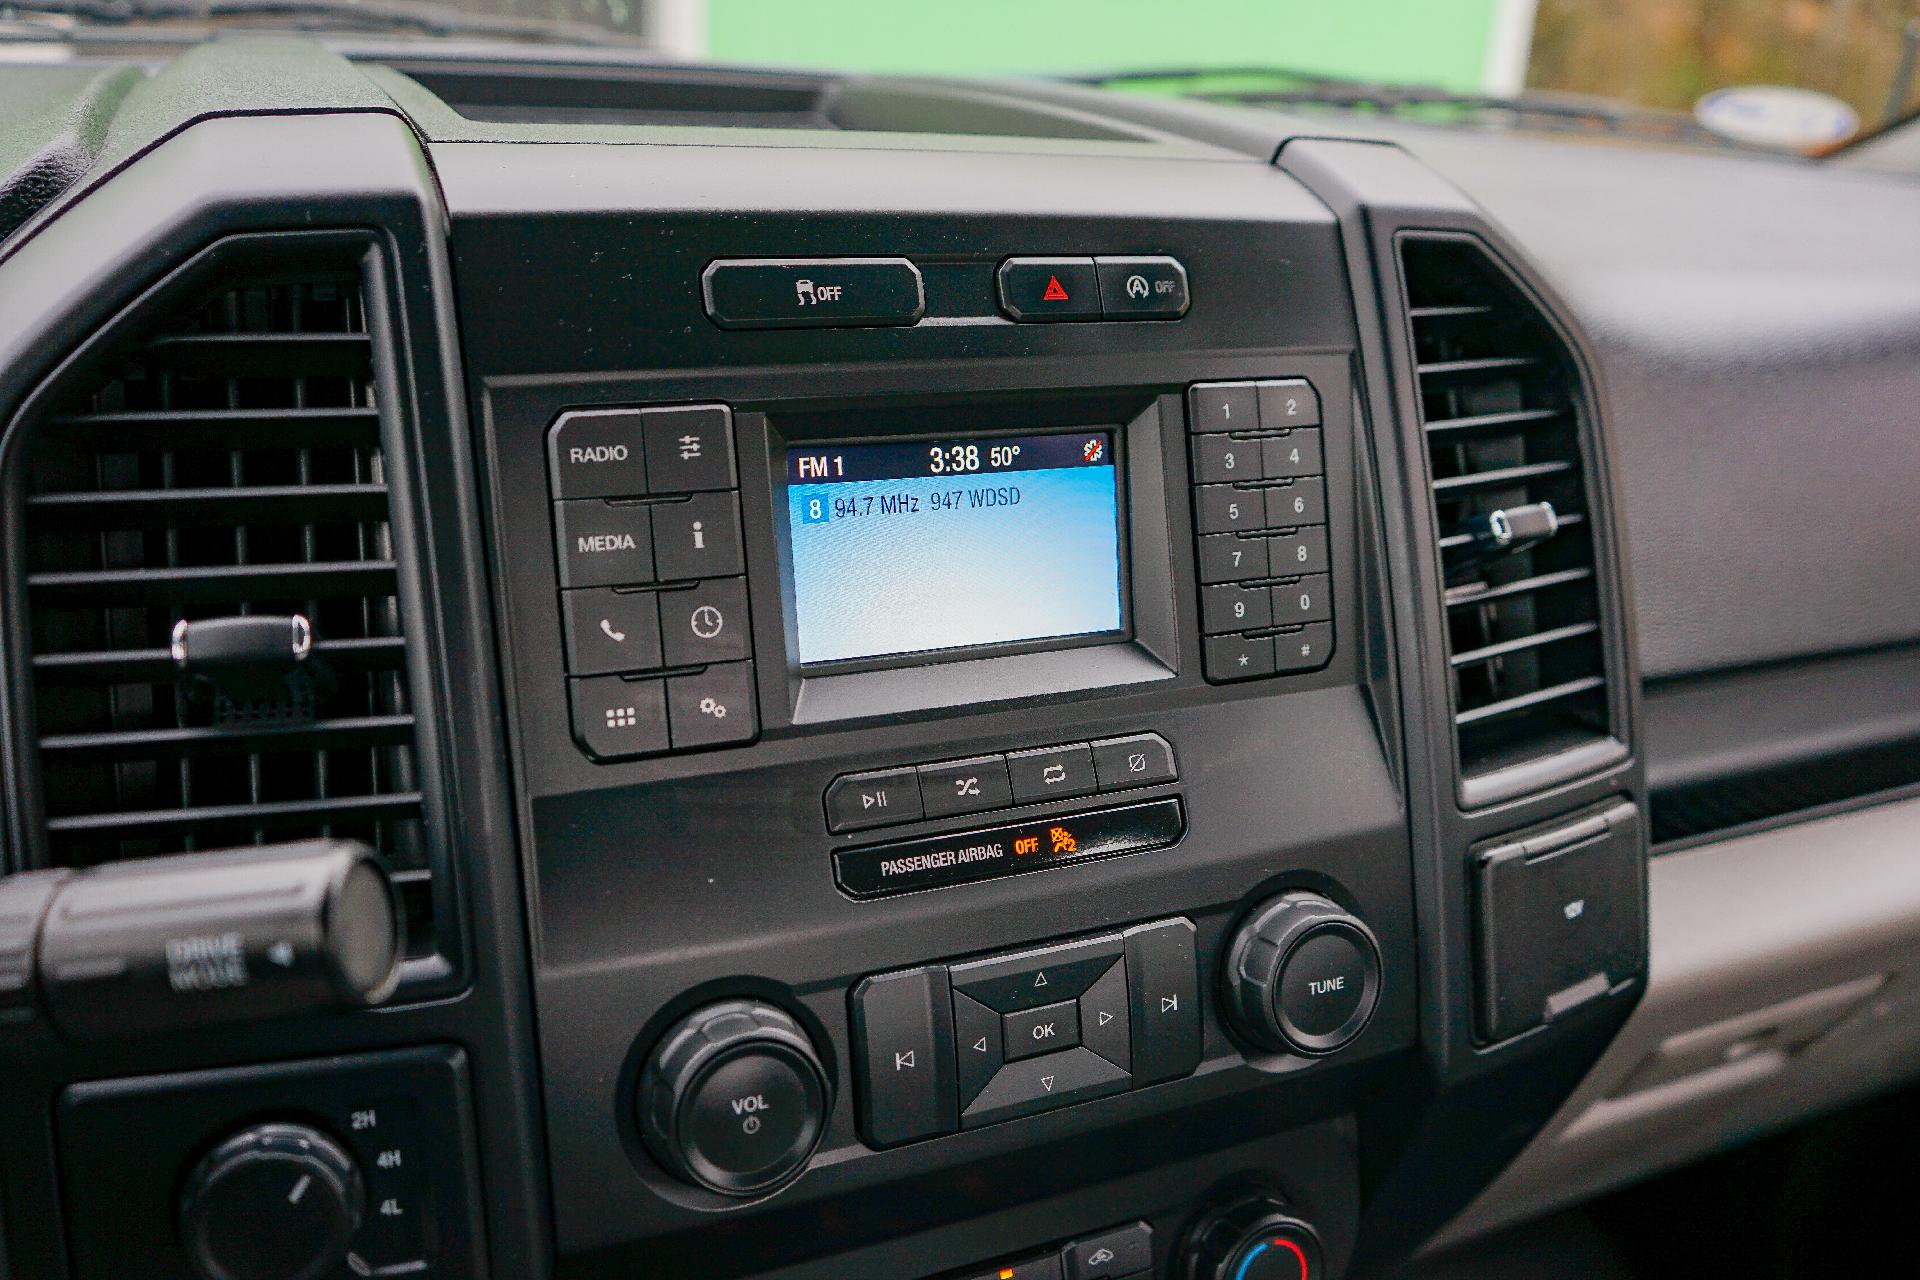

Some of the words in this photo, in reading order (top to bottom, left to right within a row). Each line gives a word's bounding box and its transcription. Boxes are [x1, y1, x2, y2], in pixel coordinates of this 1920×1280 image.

[817, 286, 842, 301] OFF
[1155, 280, 1175, 294] OFF
[1222, 403, 1231, 420] 1
[1286, 398, 1297, 416] 2
[570, 445, 628, 463] RADIO
[930, 445, 980, 473] 3:38
[990, 445, 1021, 467] 50°
[1225, 452, 1235, 470] 3
[1289, 448, 1300, 465] 4
[799, 456, 828, 478] FM
[833, 456, 843, 476] 1
[809, 499, 822, 519] 8
[835, 496, 874, 518] 94.7
[881, 494, 920, 515] MHz
[930, 491, 963, 511] 947
[968, 487, 1021, 508] WDSD
[1229, 503, 1239, 521] 5
[1294, 496, 1305, 514] 6
[577, 533, 637, 553] MEDIA
[1232, 551, 1242, 568] 7
[1297, 544, 1308, 563] 8
[1234, 601, 1246, 619] 9
[1300, 594, 1311, 611] 0
[880, 851, 958, 877] PASSENGER
[957, 843, 1004, 864] AIRBAG
[1015, 836, 1039, 855] OFF
[1308, 976, 1345, 996] TUNE
[1032, 1022, 1056, 1040] OK
[731, 1094, 769, 1115] VOL
[350, 1109, 376, 1130] 2H
[376, 1149, 402, 1169] 4H
[380, 1198, 404, 1216] 4L
